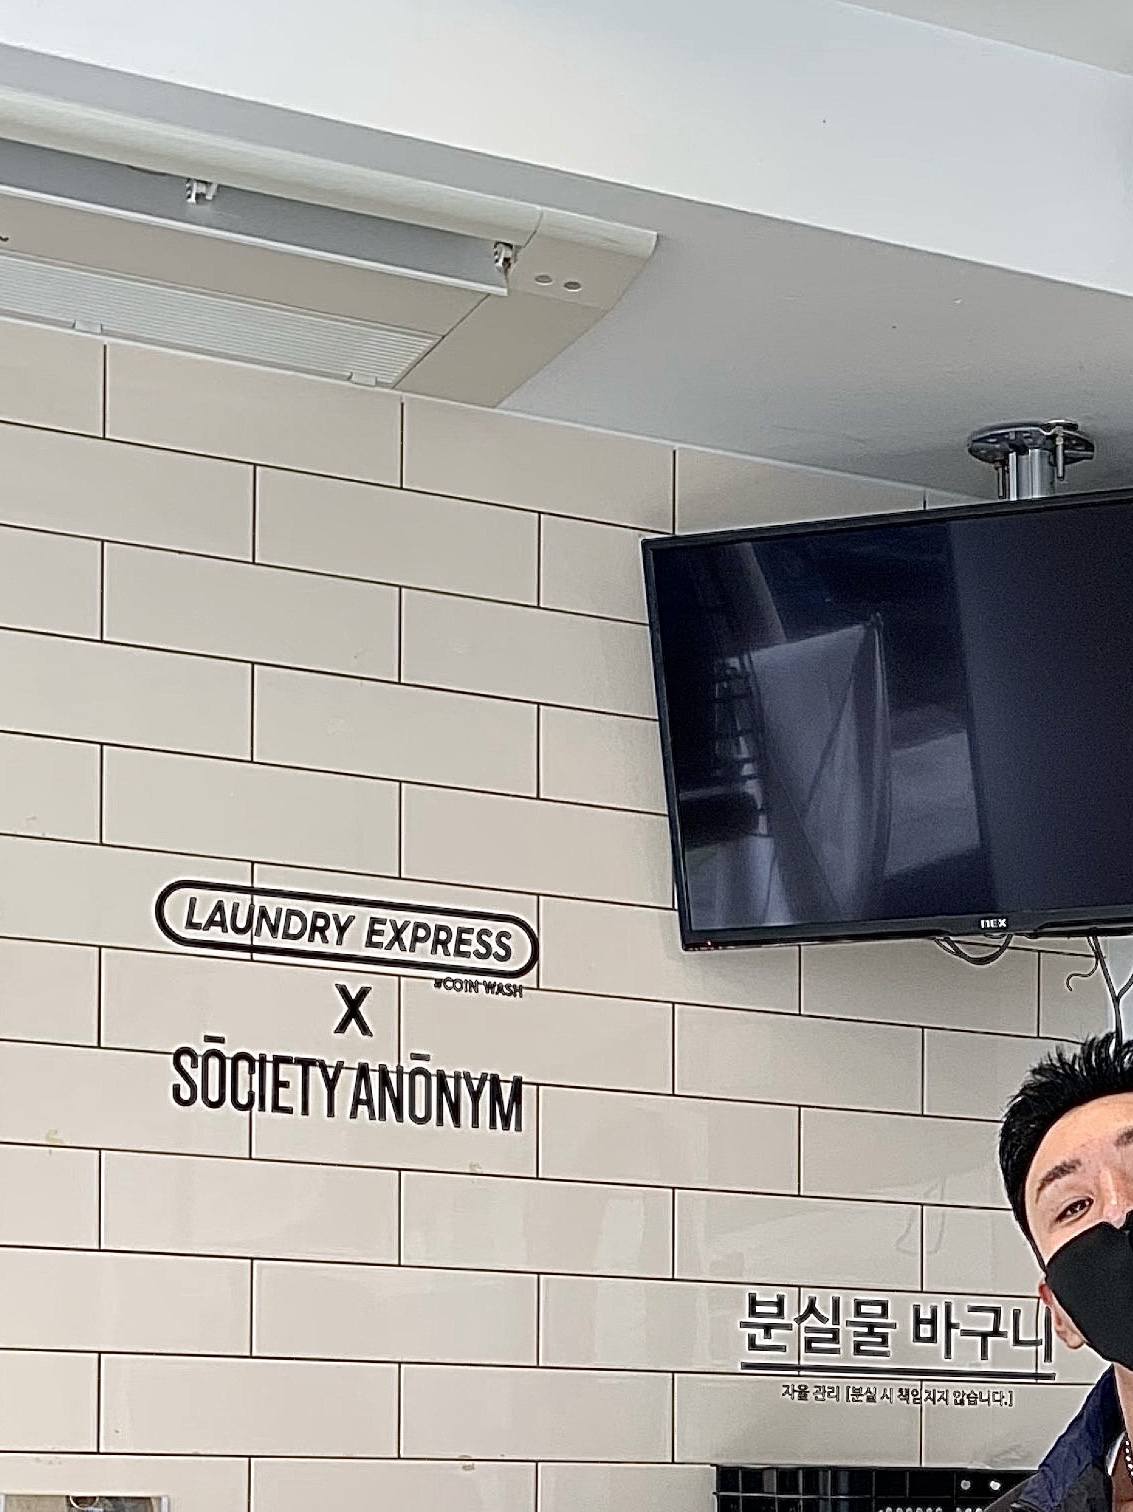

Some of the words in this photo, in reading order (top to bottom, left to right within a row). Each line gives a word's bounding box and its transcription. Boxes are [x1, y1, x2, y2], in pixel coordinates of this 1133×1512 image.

[184, 896, 356, 946] LAUNDRY
[364, 916, 512, 963] EXPRESS
[334, 983, 373, 1037] X
[482, 981, 524, 999] WASH
[739, 1292, 897, 1357] 분실물
[912, 1301, 1053, 1363] 바구니
[813, 1385, 840, 1402] 관리
[846, 1386, 877, 1403] [분실
[880, 1387, 893, 1404] 시
